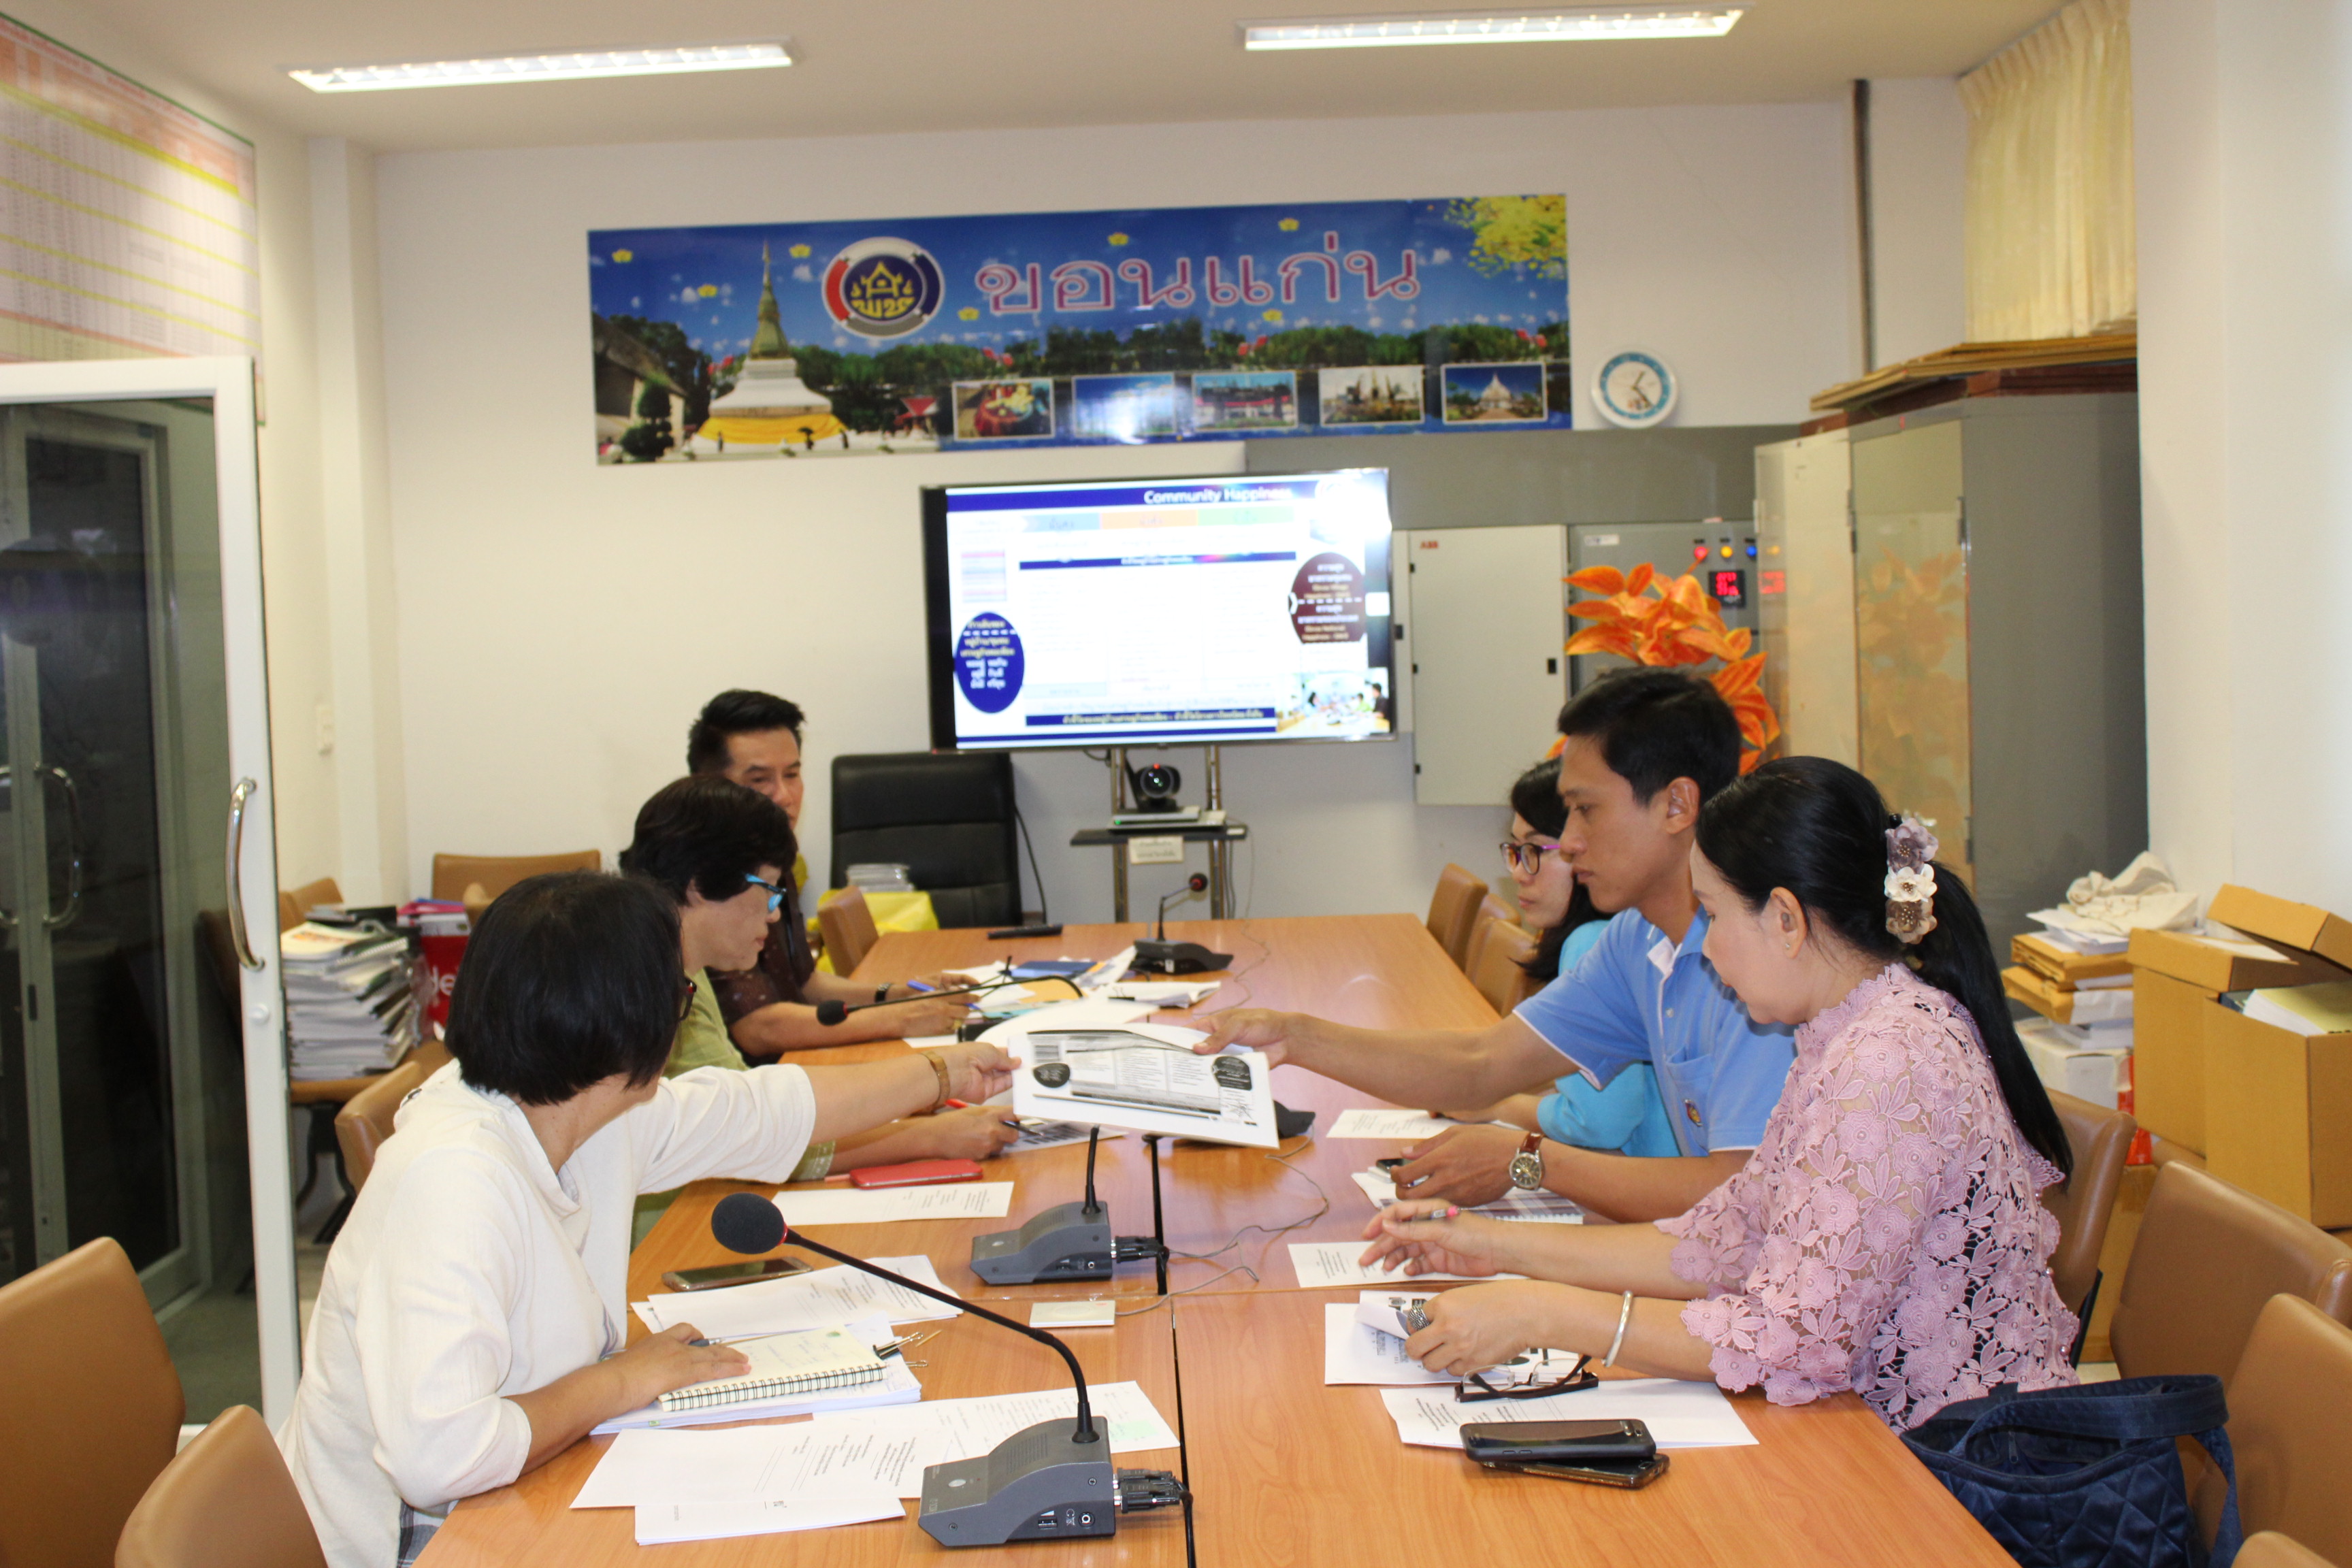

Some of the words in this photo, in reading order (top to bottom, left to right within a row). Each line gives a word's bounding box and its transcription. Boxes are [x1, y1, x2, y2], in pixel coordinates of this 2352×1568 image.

[976, 231, 1420, 312] ขอนแก่น
[1144, 488, 1222, 504] Community
